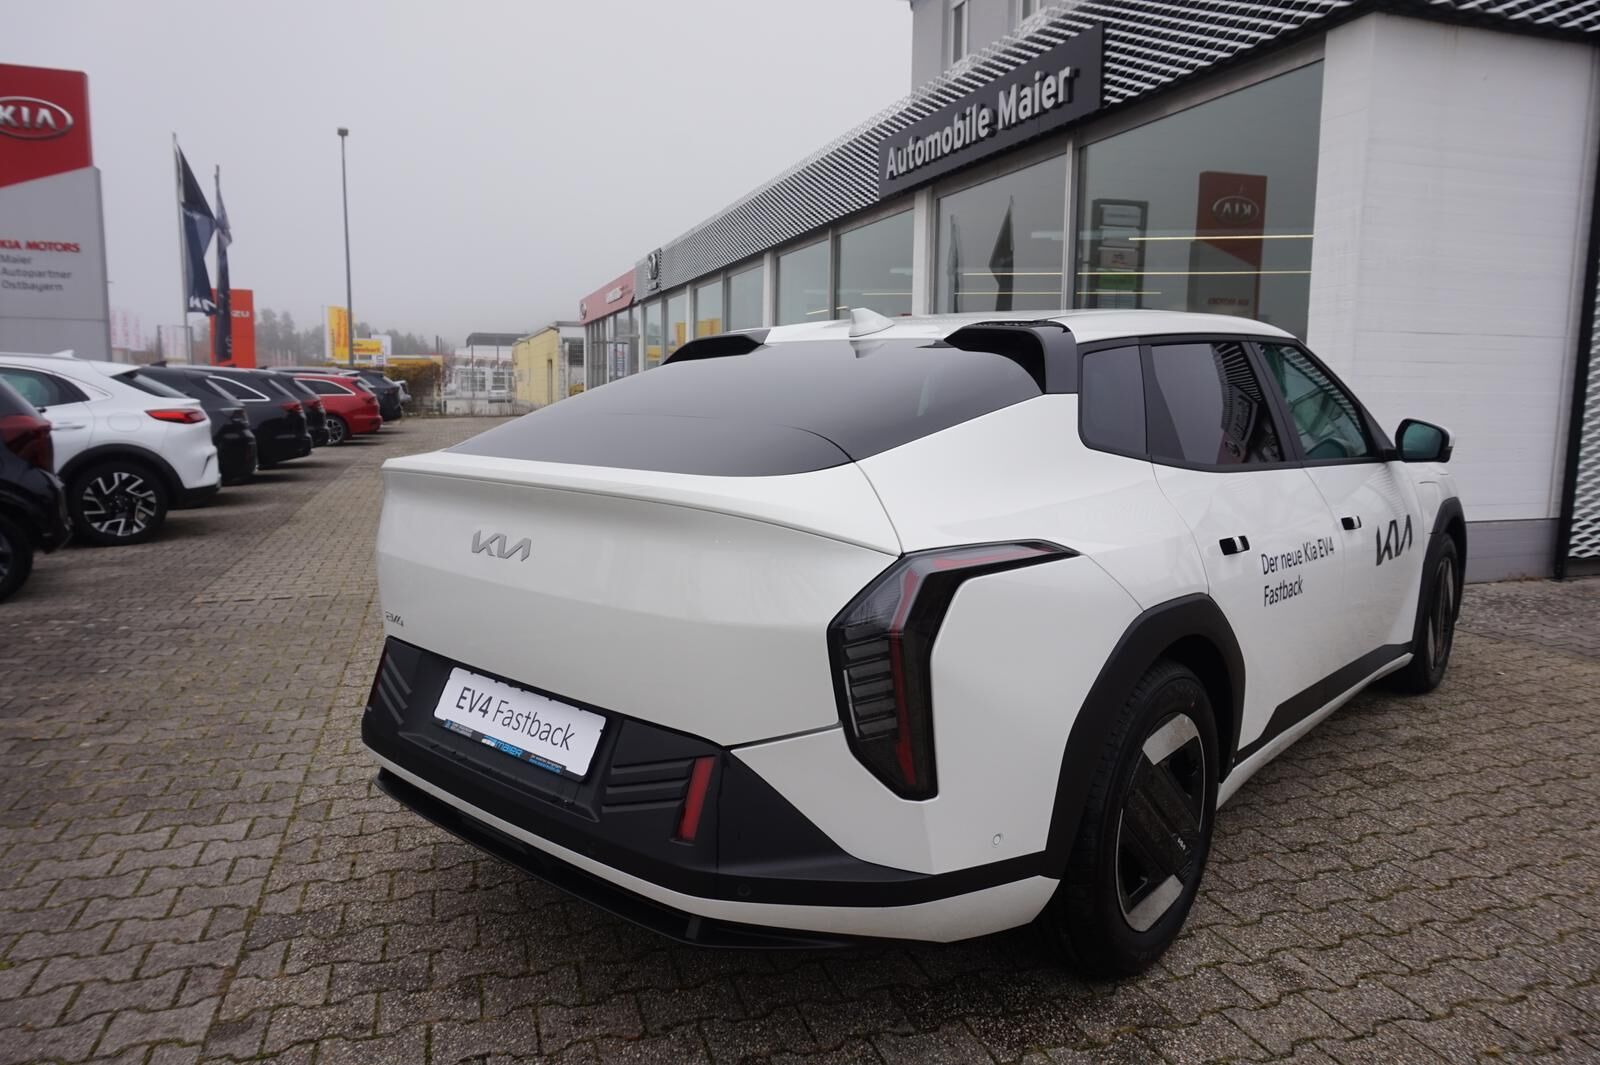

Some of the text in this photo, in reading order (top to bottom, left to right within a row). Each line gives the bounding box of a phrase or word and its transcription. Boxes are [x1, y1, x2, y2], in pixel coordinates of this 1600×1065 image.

[0, 104, 57, 129] KIA
[886, 66, 1072, 180] Automobile Maier
[26, 241, 81, 253] MOTORS
[1261, 536, 1335, 575] Der neue Kia EV4
[1263, 575, 1304, 607] Fastback
[455, 686, 493, 719] EV4
[492, 700, 576, 751] Fastback
